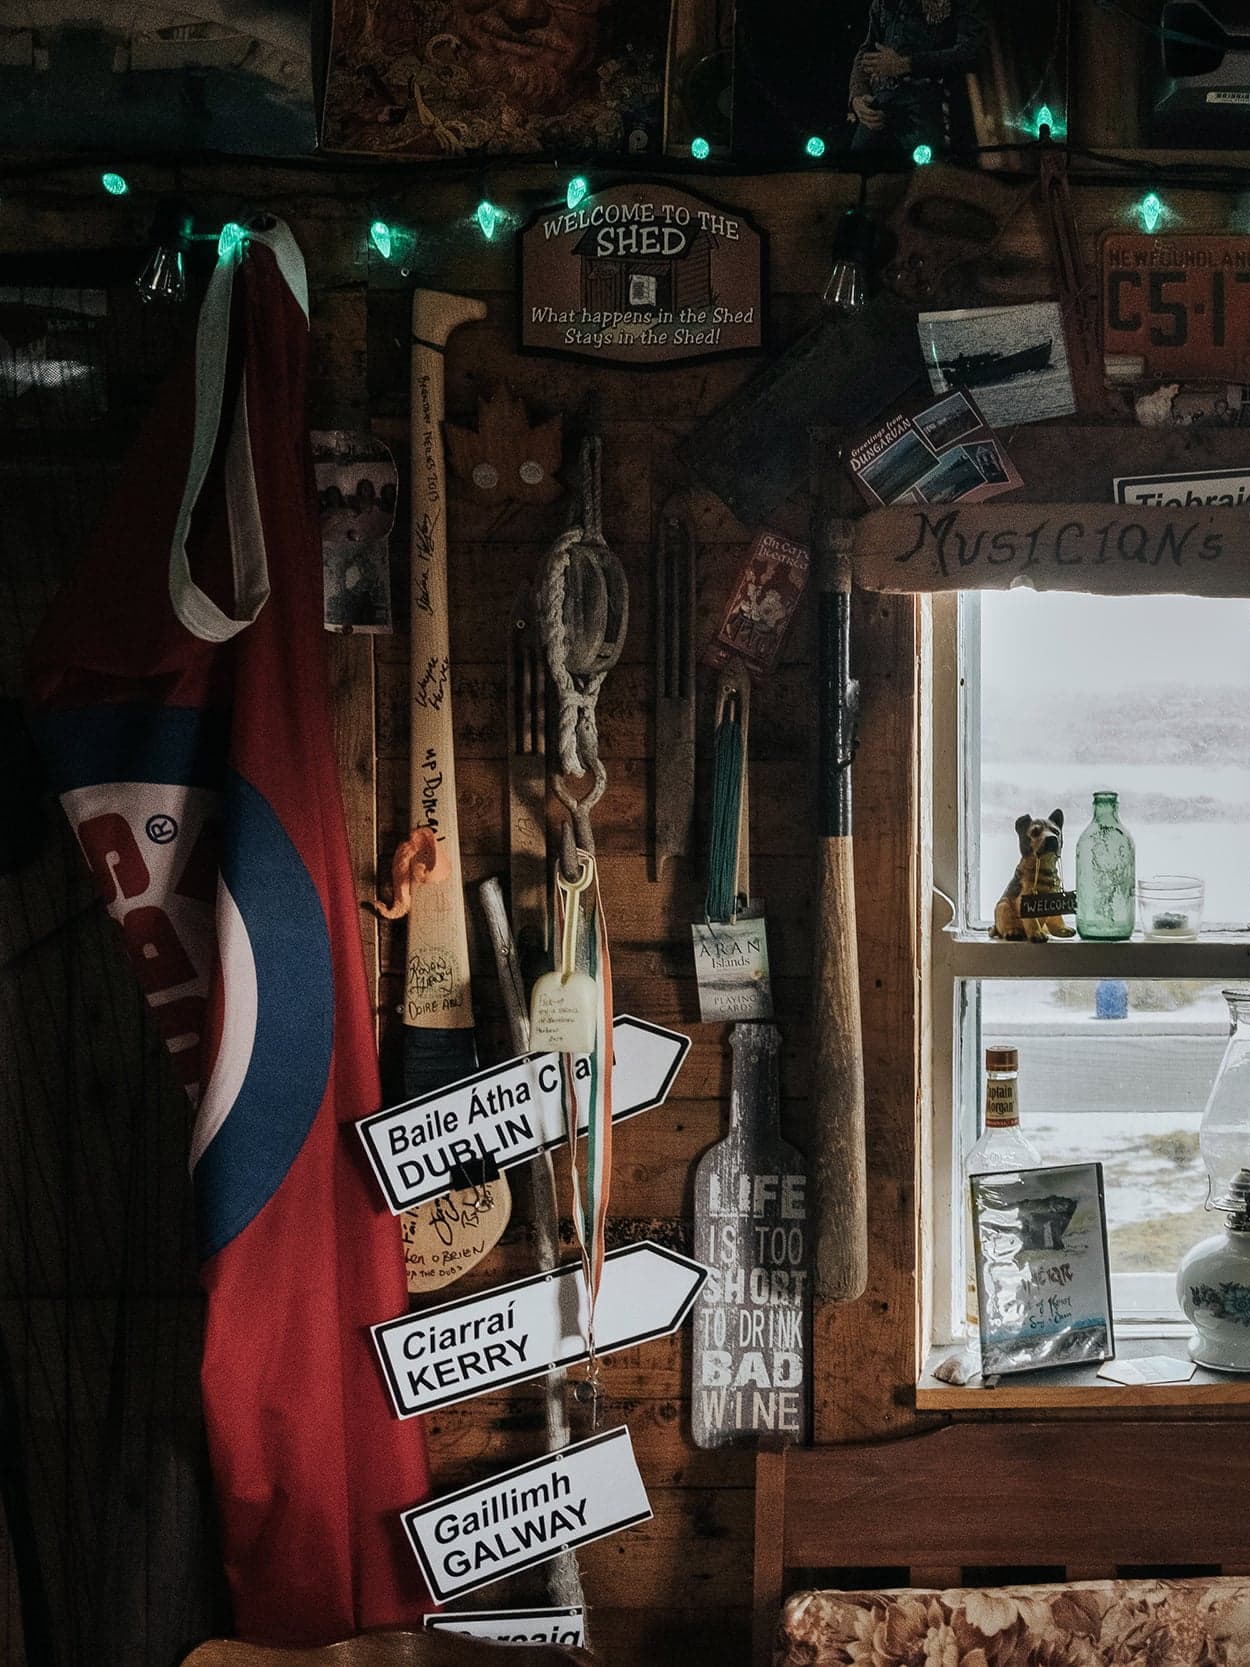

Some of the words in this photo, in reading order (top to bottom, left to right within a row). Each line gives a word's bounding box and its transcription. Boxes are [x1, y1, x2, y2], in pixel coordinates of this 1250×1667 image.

[544, 203, 655, 240] WELCOME
[662, 205, 690, 226] TO
[698, 211, 739, 240] THE
[597, 224, 686, 257] SHED
[531, 307, 576, 324] What
[581, 307, 652, 328] happens
[658, 310, 673, 323] in
[680, 307, 707, 324] the
[713, 307, 754, 324] Shed
[564, 328, 613, 348] Stays
[618, 329, 636, 344] in
[640, 329, 669, 345] the
[673, 328, 721, 345] Shed!
[700, 939, 760, 957] ARAN
[712, 955, 751, 969] Islands
[714, 994, 759, 1005] PLAYING
[720, 1003, 753, 1014] CARDS
[988, 1085, 1013, 1101] ptain
[388, 1110, 458, 1155] Baile
[468, 1088, 531, 1125] Átha
[397, 1113, 535, 1190] DUBLIN
[709, 1173, 807, 1220] LIFE
[708, 1225, 738, 1263] IS
[754, 1226, 804, 1265] TOO
[703, 1267, 807, 1306] SHORT
[402, 1300, 516, 1360] Ciarraí
[701, 1308, 727, 1348] TO
[739, 1309, 803, 1348] DRINK
[407, 1334, 529, 1396] KERRY
[702, 1350, 803, 1388] BAD
[702, 1391, 801, 1430] WINE
[434, 1472, 571, 1545] Gaillimh
[443, 1498, 587, 1577] GALWAY
